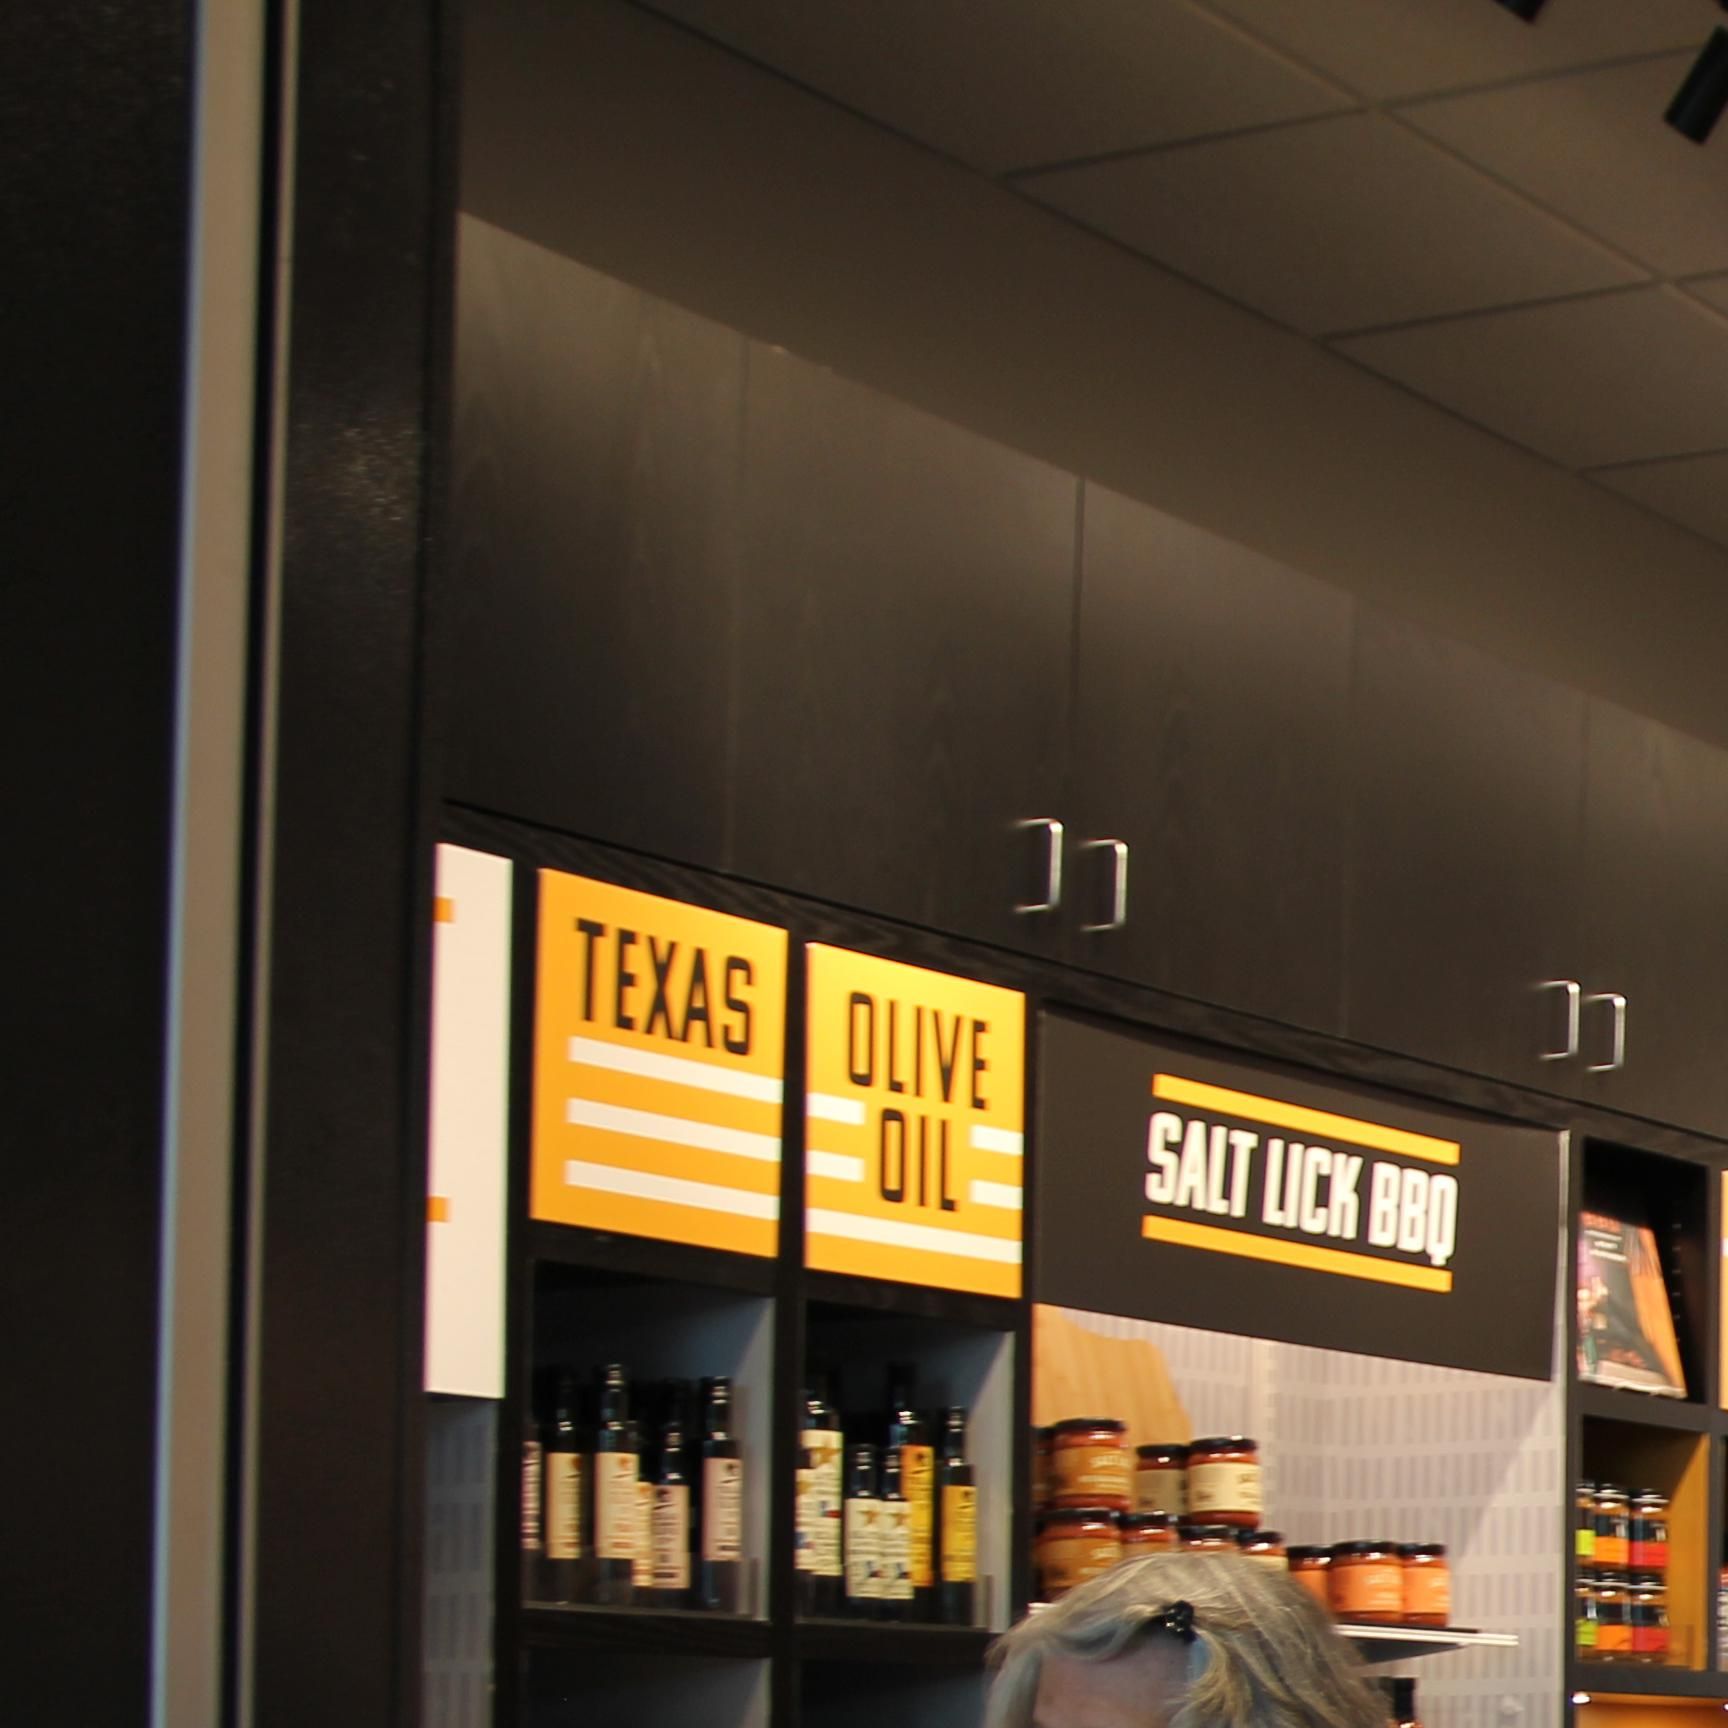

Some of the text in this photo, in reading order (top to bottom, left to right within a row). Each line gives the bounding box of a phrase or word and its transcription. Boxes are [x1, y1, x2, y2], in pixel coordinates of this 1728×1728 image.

[575, 918, 754, 1057] TEXAS
[847, 991, 990, 1111] OLIVE
[878, 1110, 959, 1213] OIL
[1144, 1111, 1460, 1267] SALT LICK BBQ
